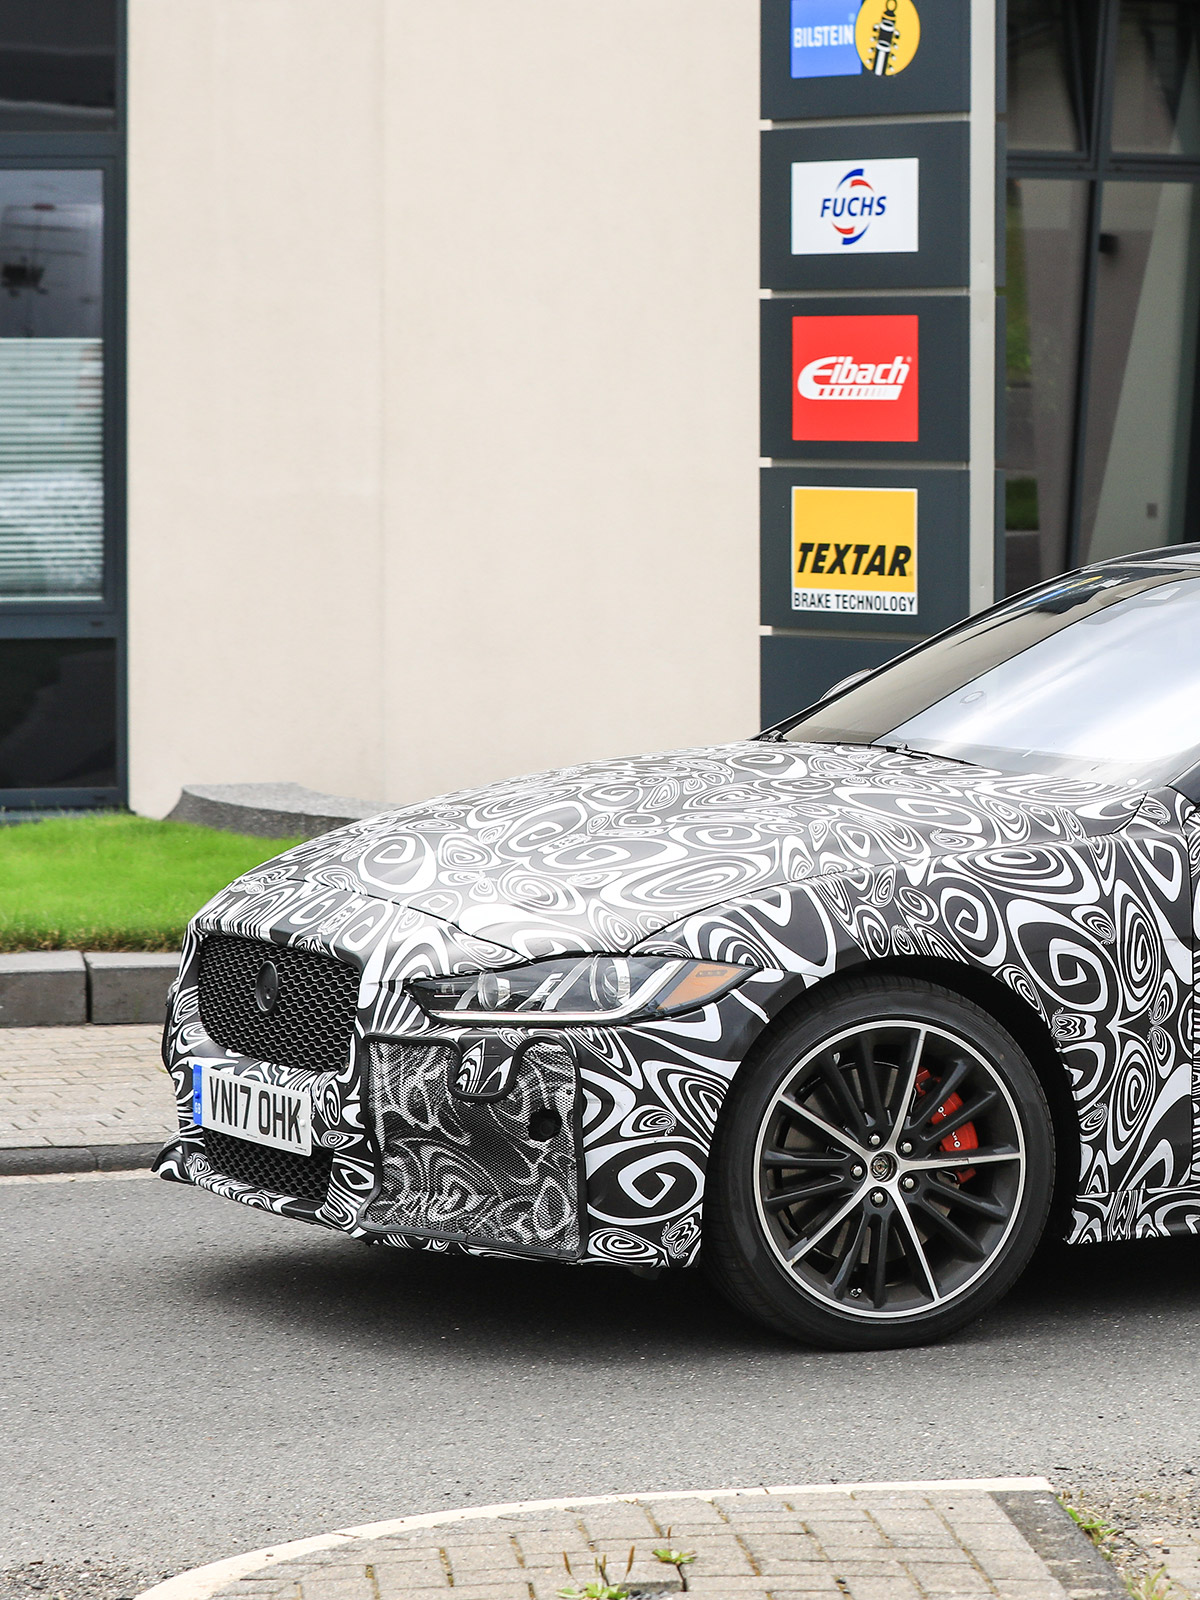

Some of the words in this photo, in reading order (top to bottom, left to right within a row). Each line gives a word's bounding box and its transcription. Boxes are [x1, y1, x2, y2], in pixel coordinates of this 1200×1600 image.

[794, 25, 854, 48] BILSTEIN
[820, 196, 887, 218] FUCHS
[797, 355, 909, 400] Eibach
[797, 542, 912, 577] TEXTAR
[794, 592, 831, 608] BRAKE
[835, 594, 915, 612] TECHNOLOGY
[209, 1075, 252, 1130] VN17
[258, 1090, 302, 1144] OHK
